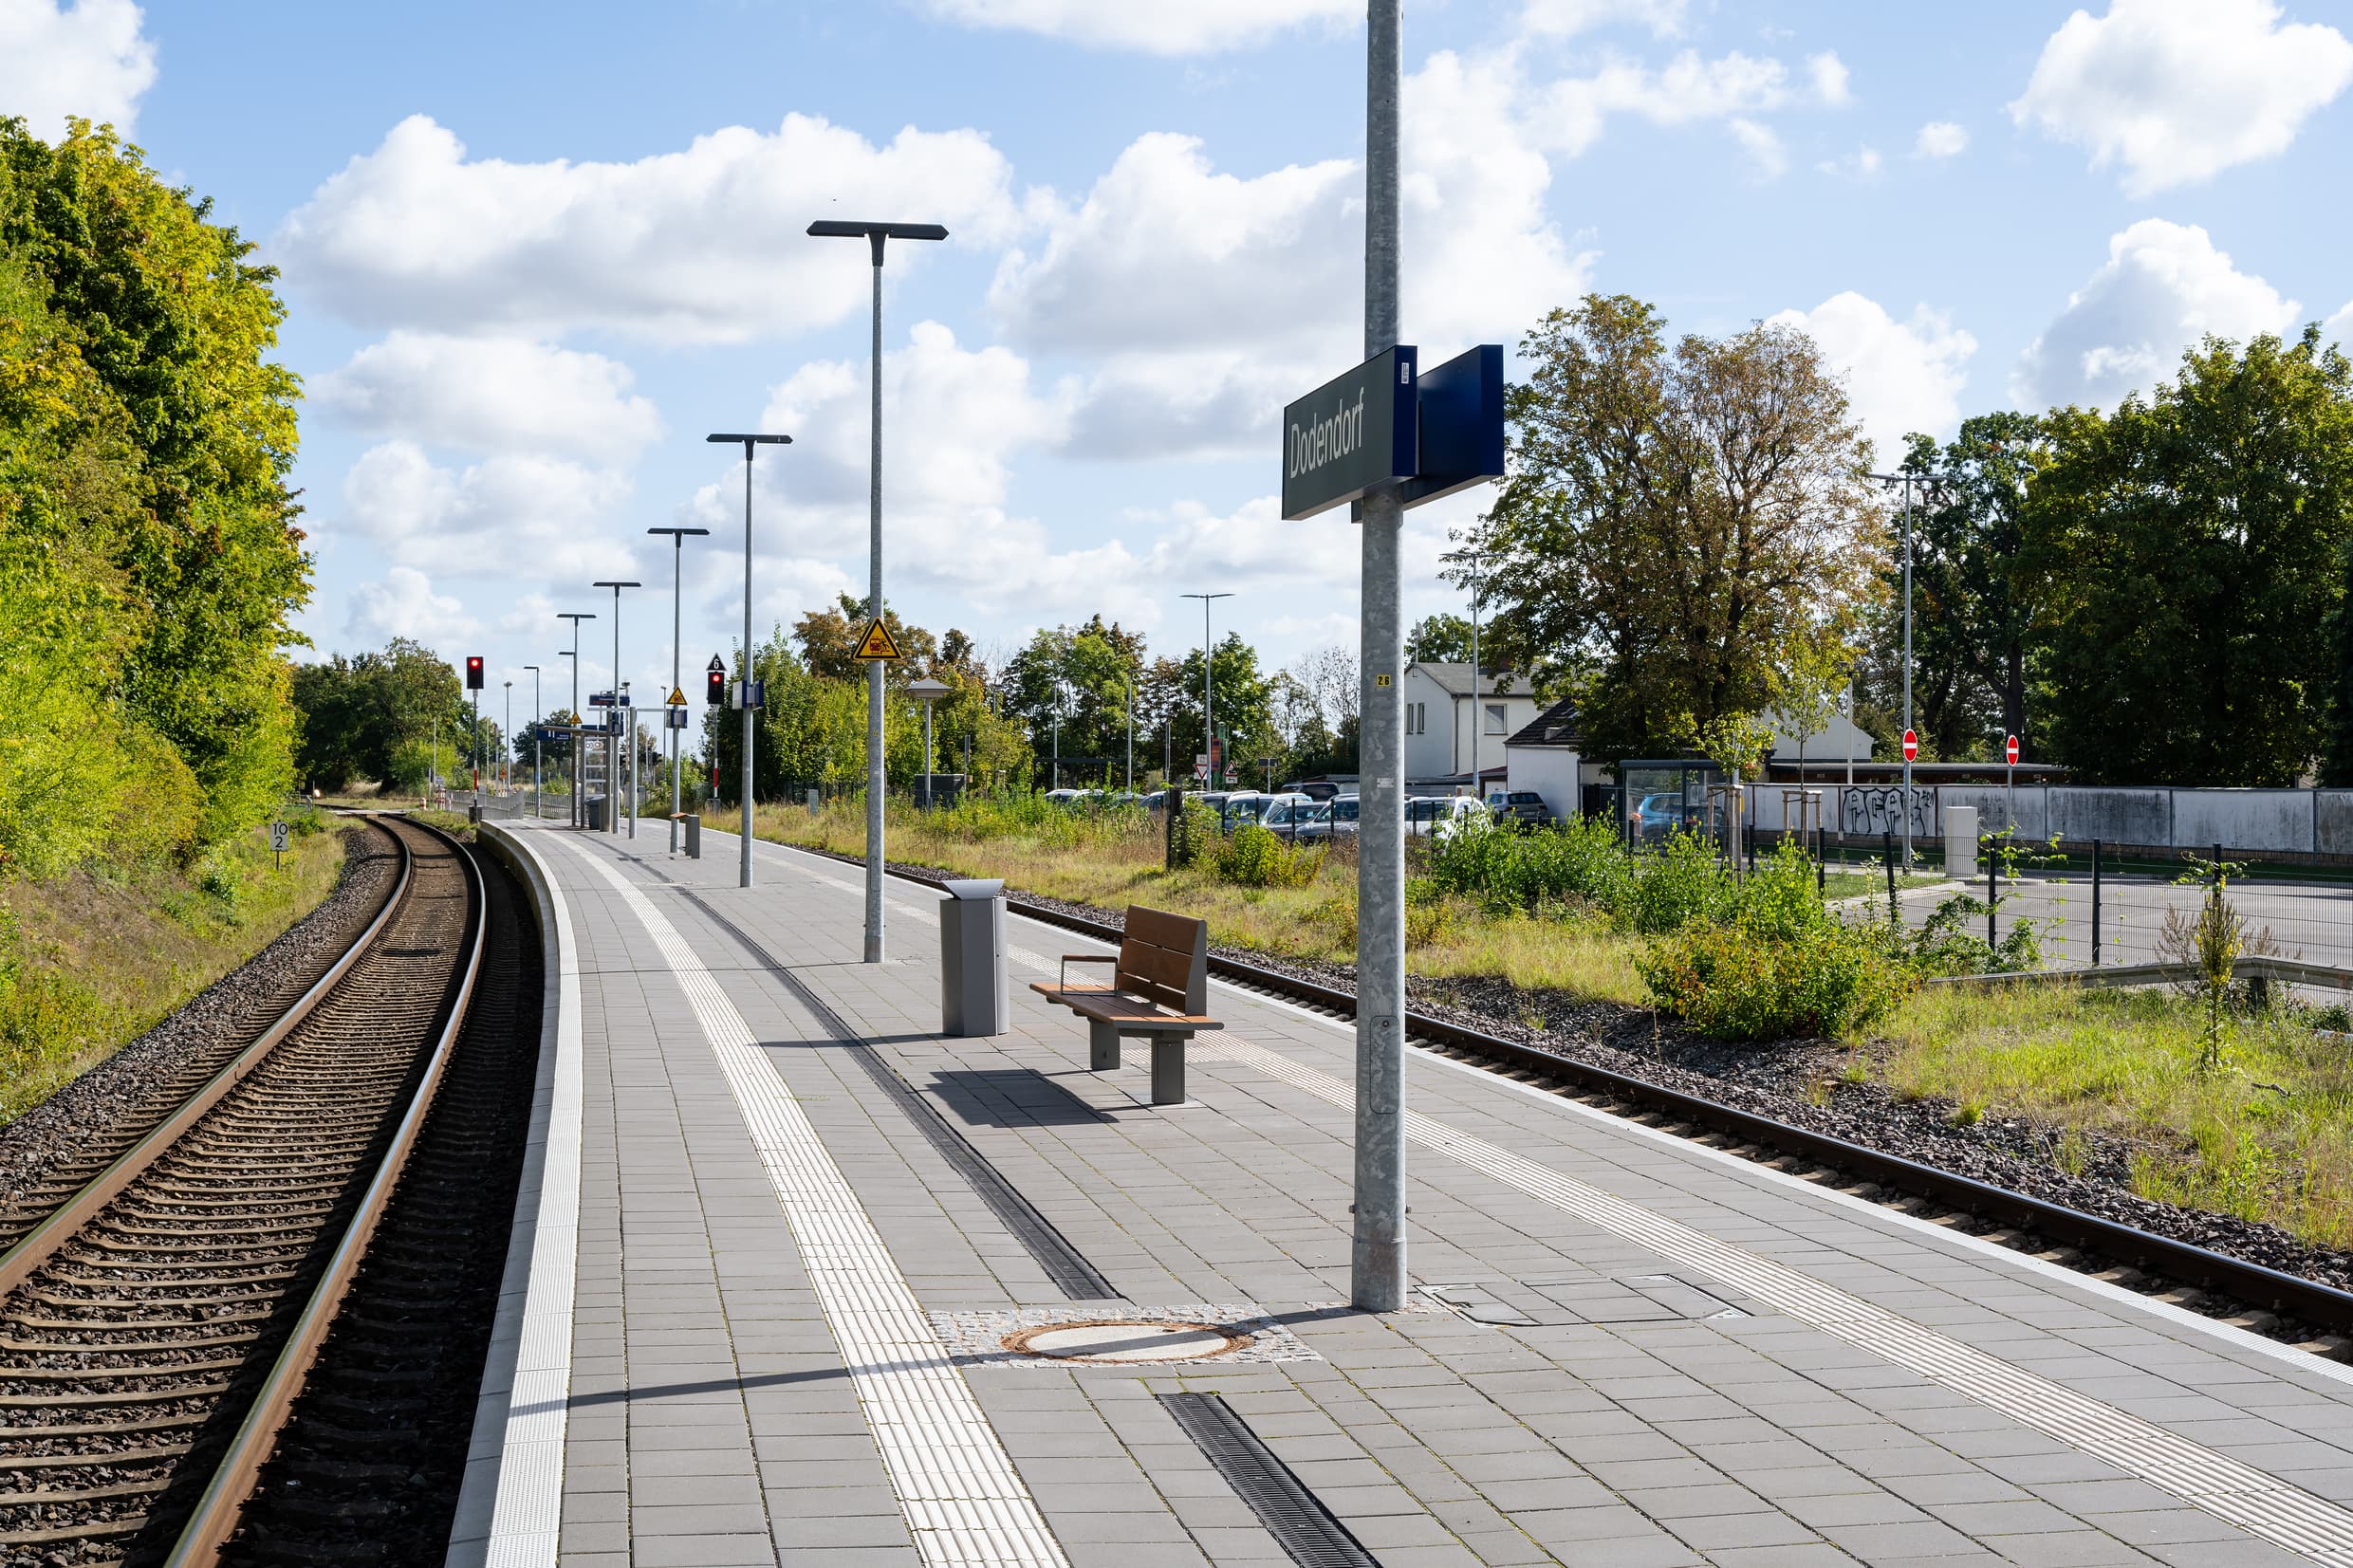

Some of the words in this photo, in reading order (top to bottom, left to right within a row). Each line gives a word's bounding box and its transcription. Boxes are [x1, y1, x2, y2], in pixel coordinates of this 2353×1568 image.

[1290, 386, 1364, 479] Dodendorf
[713, 658, 719, 669] 6
[1379, 676, 1389, 685] 26
[272, 823, 288, 836] 10
[275, 837, 283, 848] 2
